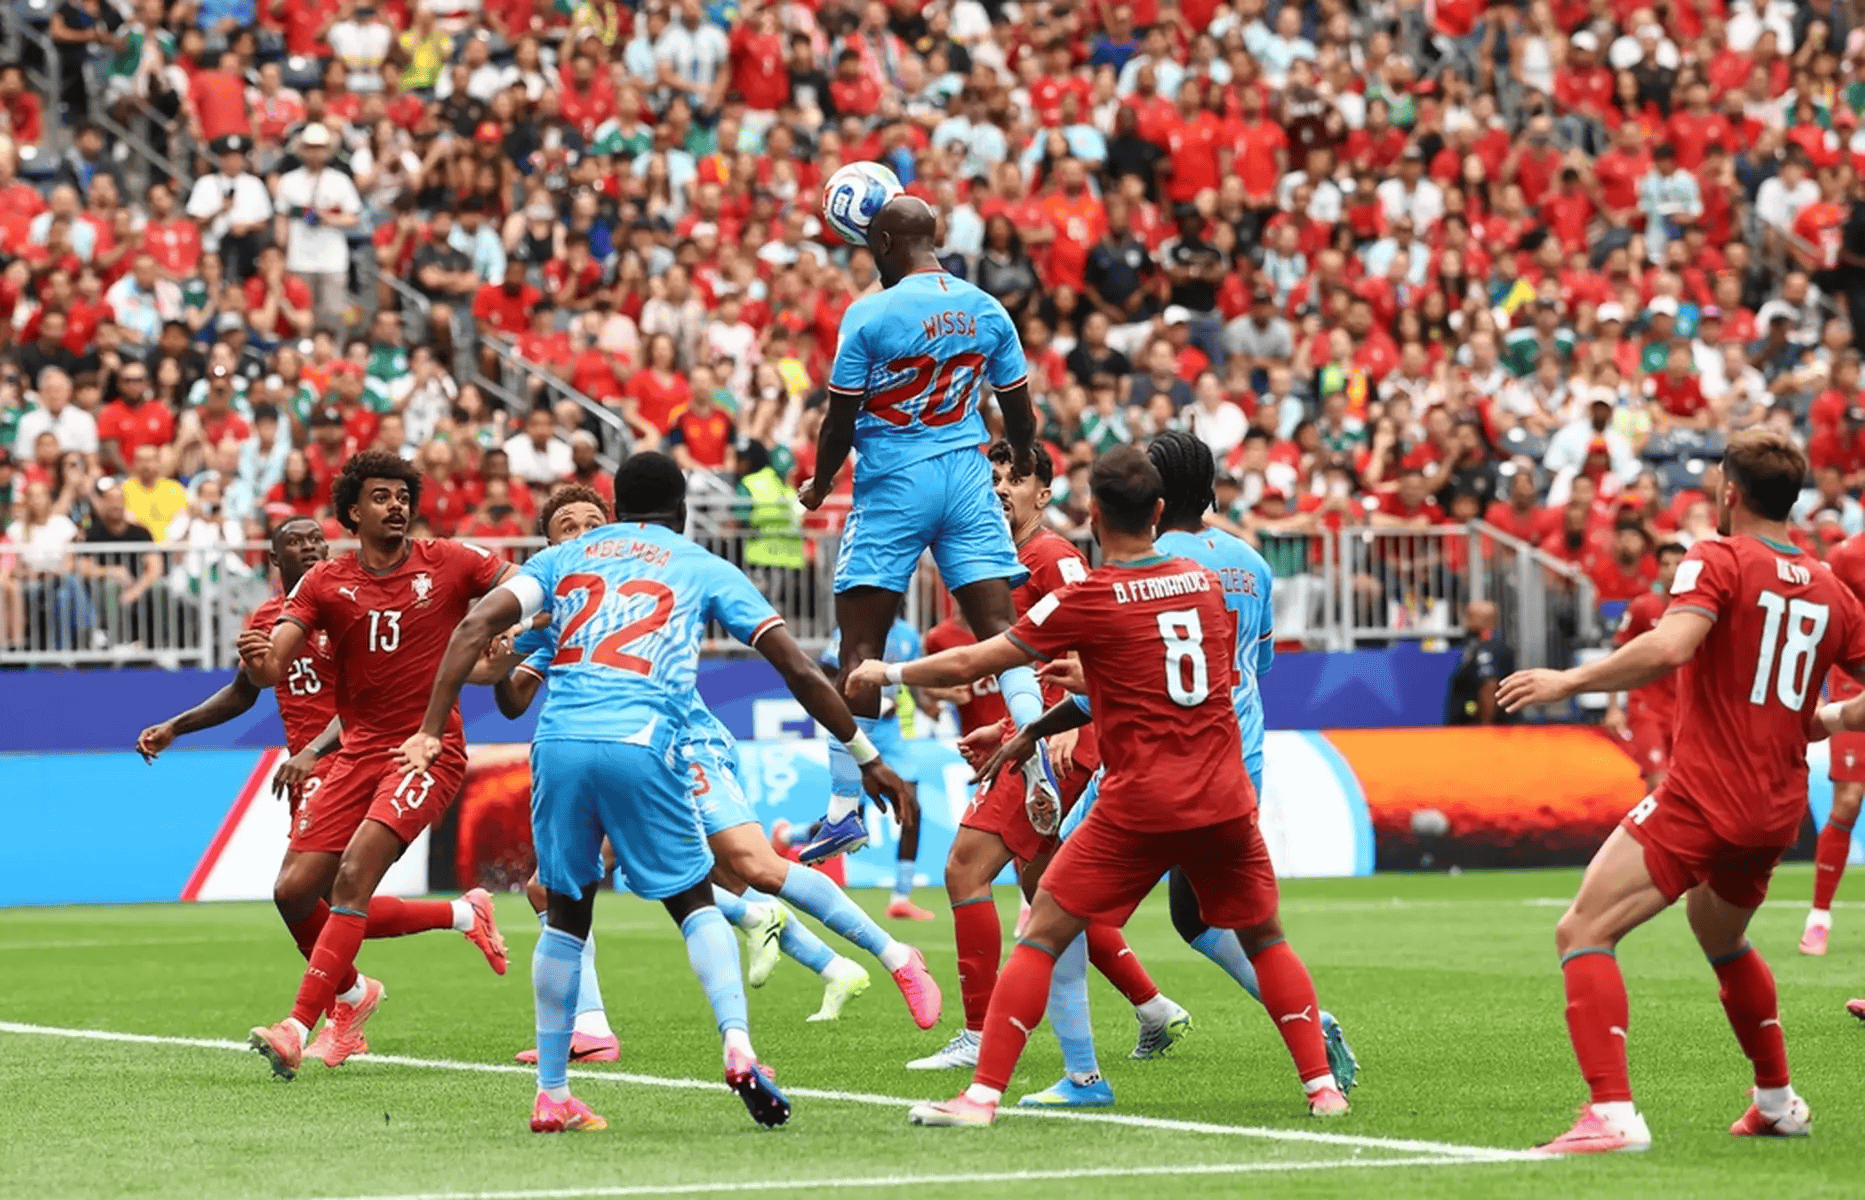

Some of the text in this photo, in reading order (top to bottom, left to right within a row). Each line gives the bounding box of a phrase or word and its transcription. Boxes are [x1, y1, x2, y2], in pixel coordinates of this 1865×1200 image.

[922, 311, 977, 340] WISSA
[866, 353, 988, 427] 20
[368, 610, 402, 652] 13
[552, 573, 675, 677] 22
[1750, 590, 1830, 711] 18
[288, 657, 321, 695] 25
[1156, 608, 1209, 707] 8
[394, 771, 436, 809] 13
